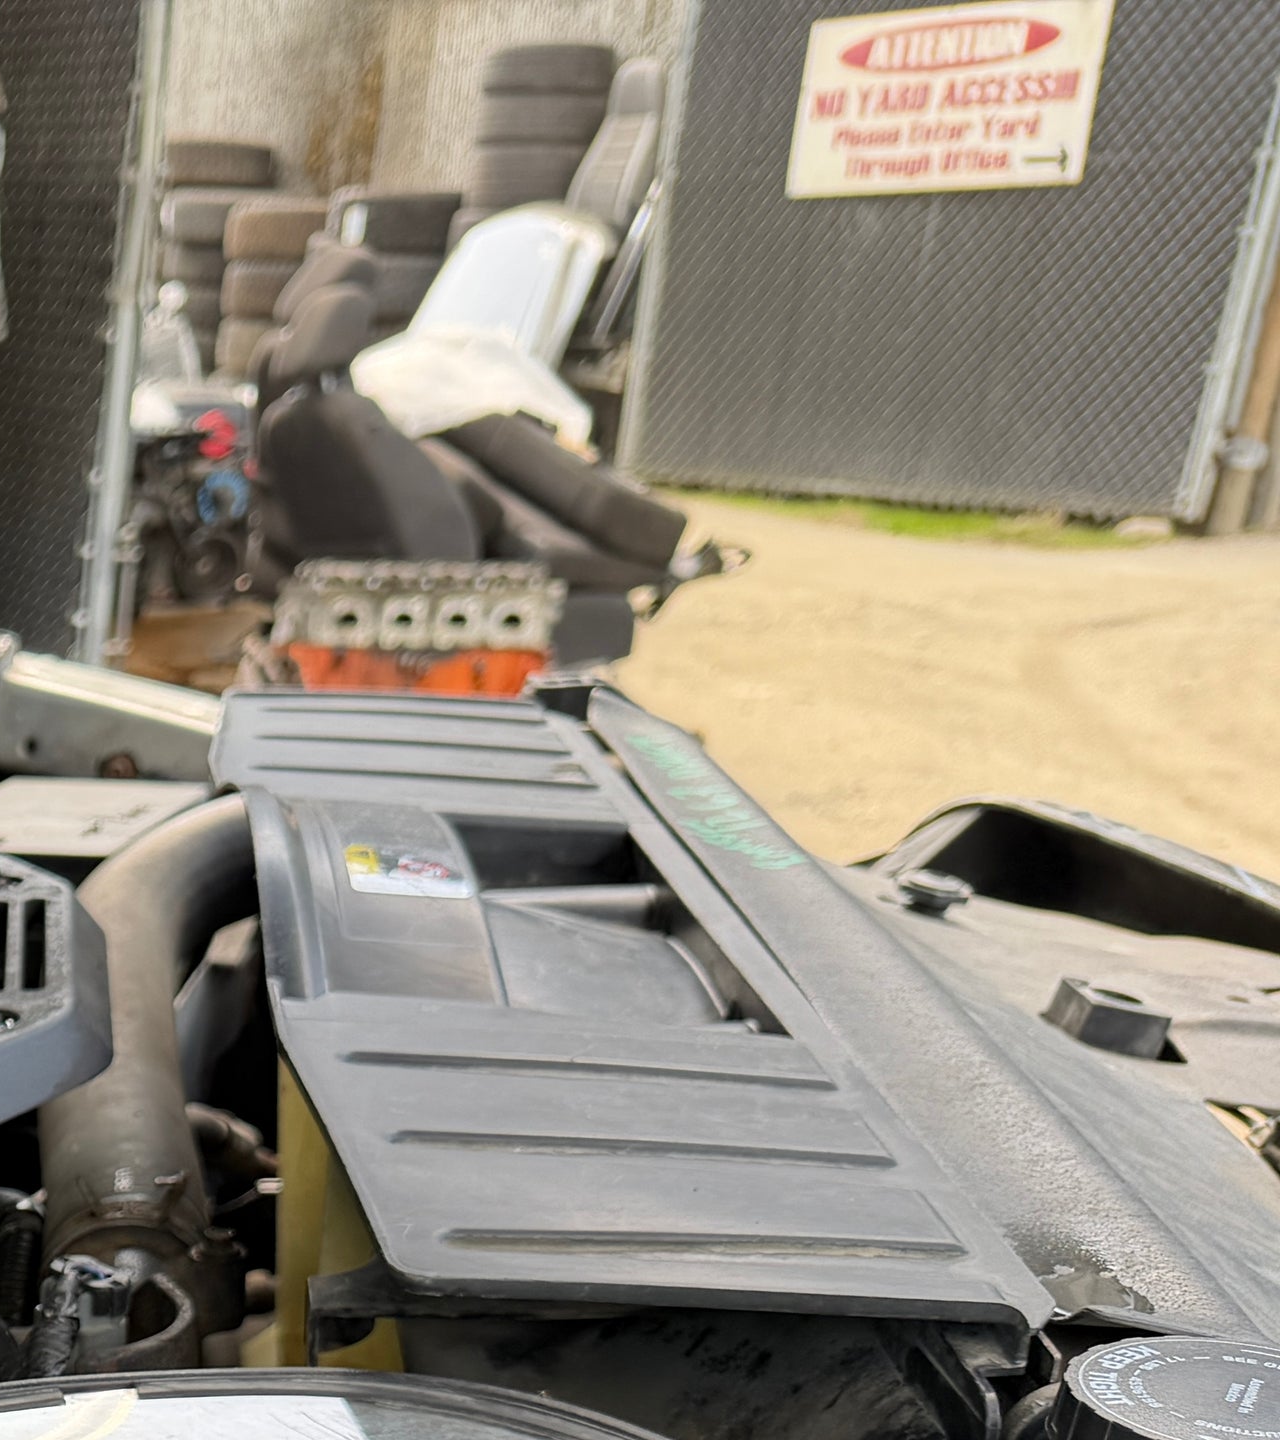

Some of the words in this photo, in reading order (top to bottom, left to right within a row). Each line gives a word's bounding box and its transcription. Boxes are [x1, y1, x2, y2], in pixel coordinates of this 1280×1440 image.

[866, 22, 1027, 68] ATTENTION
[858, 82, 931, 114] YARD
[983, 115, 1039, 138] Yard
[1099, 1346, 1160, 1370] KEEP
[1087, 1371, 1134, 1406] TIGHT
